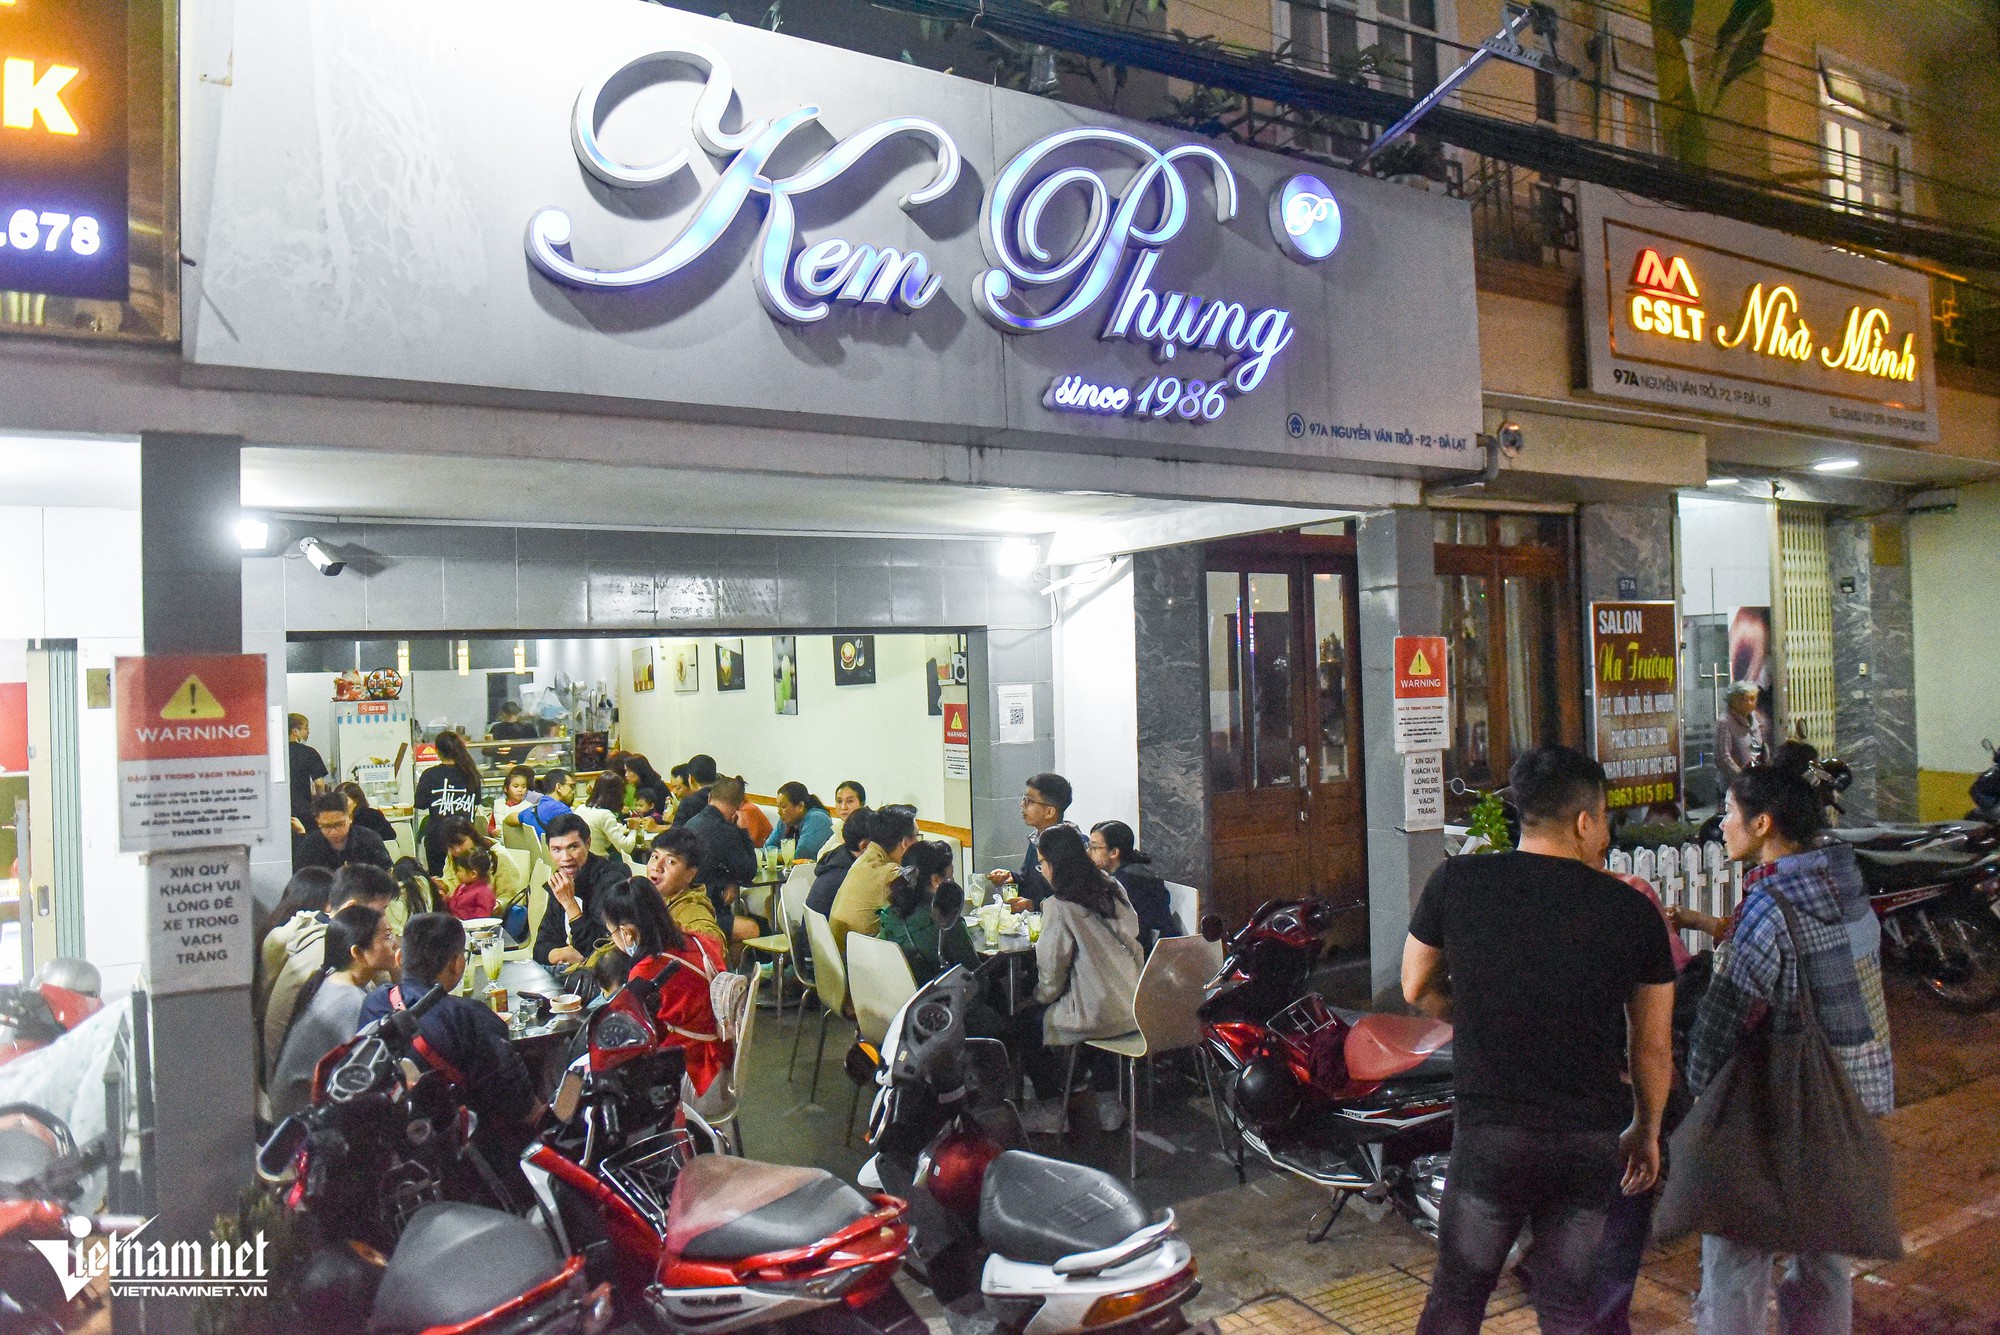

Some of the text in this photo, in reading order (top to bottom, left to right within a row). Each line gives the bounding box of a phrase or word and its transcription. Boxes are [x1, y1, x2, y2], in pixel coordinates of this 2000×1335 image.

[525, 39, 1295, 392] Kem Phụng
[1631, 295, 1705, 342] CSLT
[1717, 282, 1916, 382] Nhà Mình
[1613, 368, 1640, 387] 97A
[1054, 375, 1228, 421] since 1986
[1309, 422, 1328, 437] 97A
[1598, 609, 1643, 635] SALON
[1400, 678, 1441, 689] WARNING
[135, 724, 252, 743] WARNING
[1414, 757, 1424, 765] XIN
[172, 829, 211, 837] THANKS
[170, 861, 230, 878] XIN QUÝ
[160, 880, 241, 897] KHÁCH VUI
[167, 899, 210, 913] LÒNG
[162, 914, 240, 932] XE TRONG
